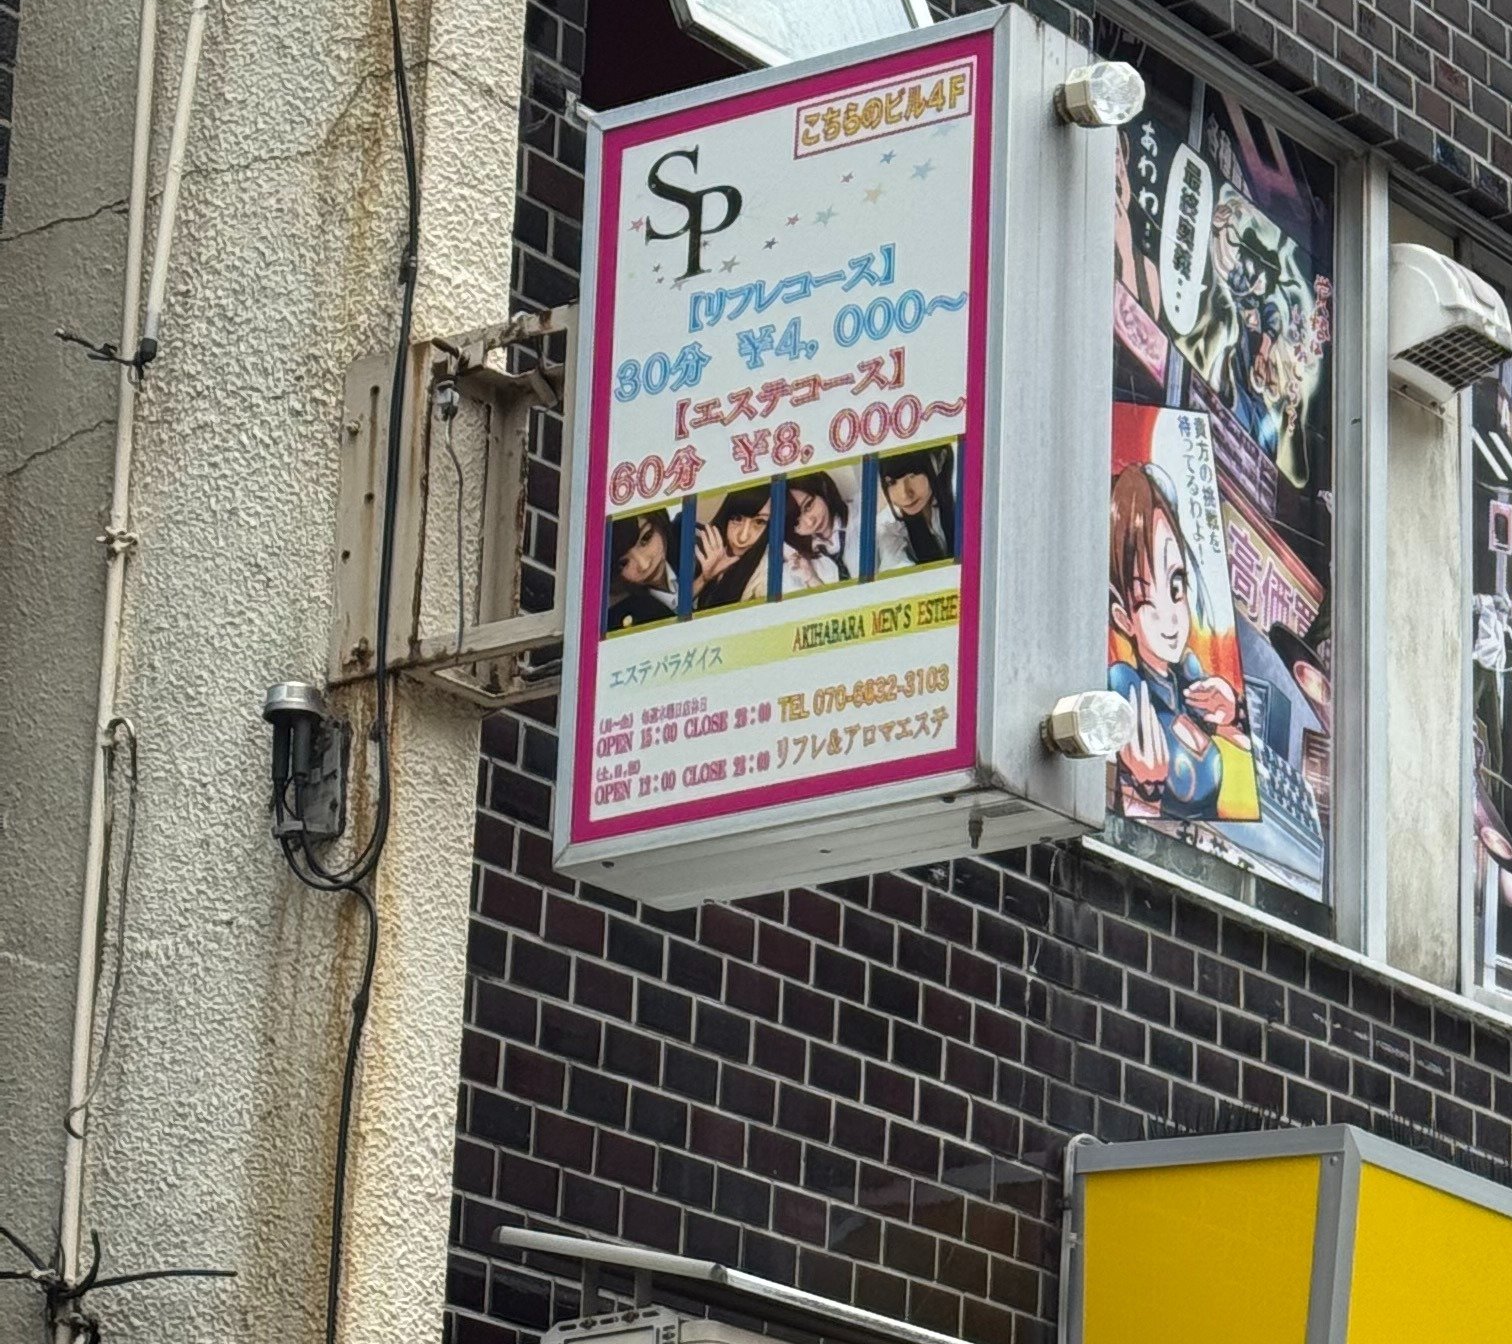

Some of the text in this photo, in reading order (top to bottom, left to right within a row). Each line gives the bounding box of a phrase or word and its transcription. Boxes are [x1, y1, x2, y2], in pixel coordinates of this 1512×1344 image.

[801, 73, 967, 147] こちらのビル4F
[645, 144, 743, 283] SP
[688, 242, 897, 333] 【リフレコース】
[614, 341, 712, 403] 30分
[673, 346, 907, 440] 【エステコース】
[608, 445, 706, 506] 60分
[793, 615, 865, 652] AKIHABARA
[609, 645, 724, 689] エステパラダイス
[597, 731, 634, 759] OPEN
[683, 710, 729, 740] CLOSE
[777, 706, 949, 769] リフレ&アロマエステ
[778, 693, 809, 723] TEL
[594, 779, 631, 806] OPEN
[682, 759, 727, 787] CLOSE
